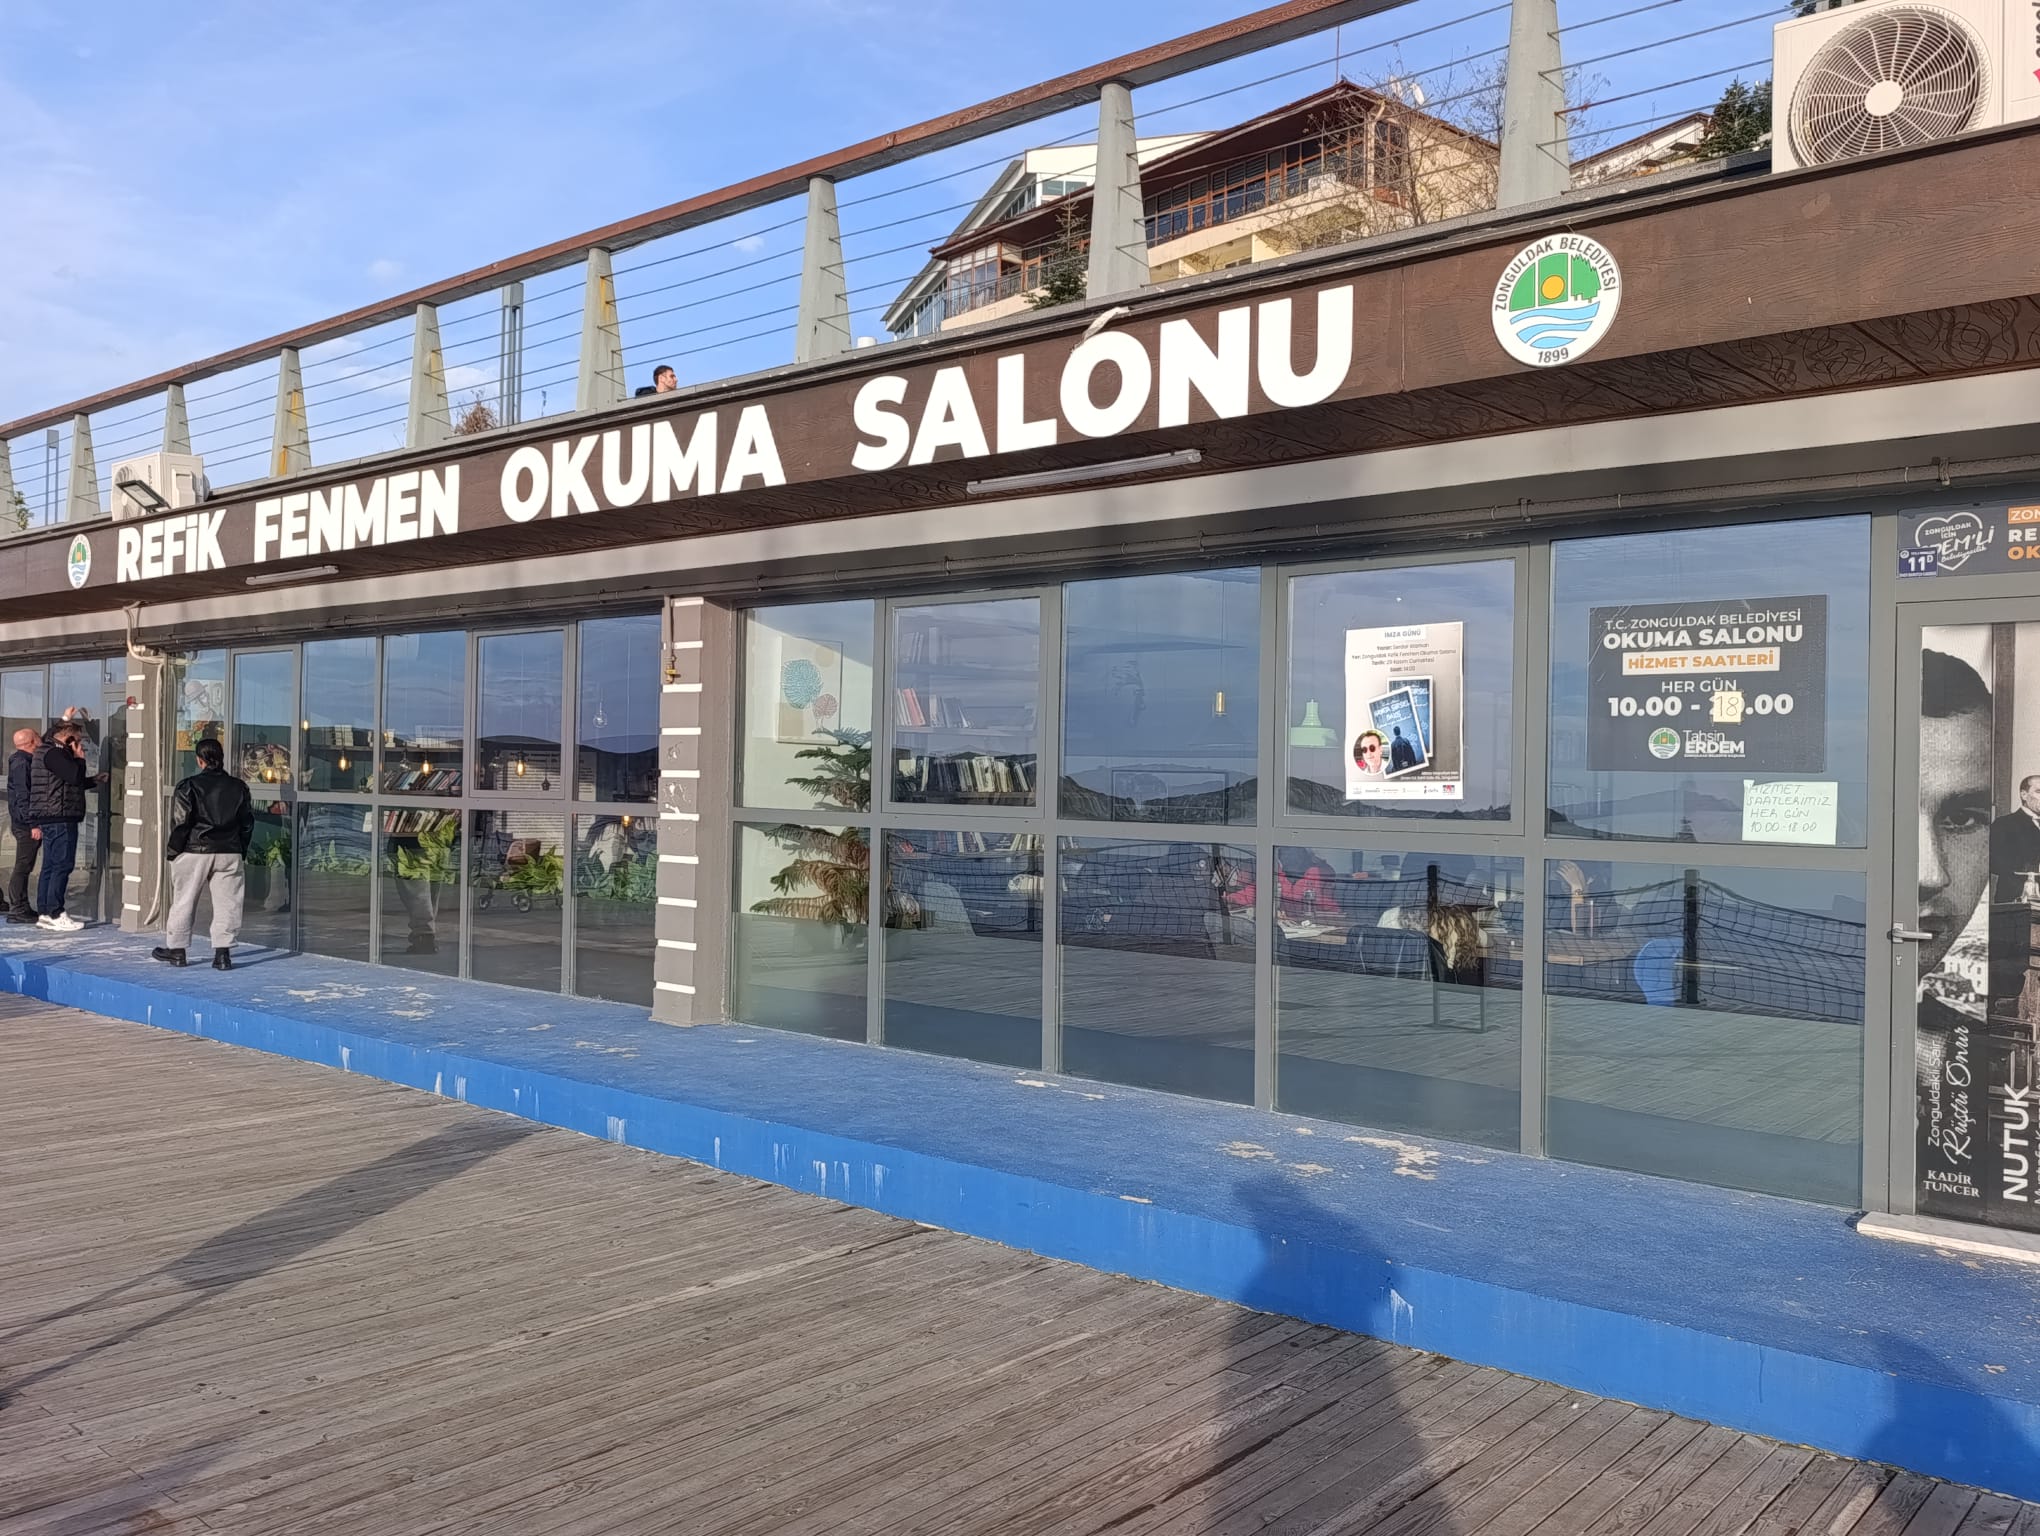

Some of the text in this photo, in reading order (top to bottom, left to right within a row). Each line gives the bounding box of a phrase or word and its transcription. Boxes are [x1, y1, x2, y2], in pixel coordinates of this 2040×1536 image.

[1494, 236, 1619, 312] ZONGULDAK BELEDİYESİ
[1537, 347, 1569, 364] 1899
[254, 464, 460, 563] FENMEN
[500, 404, 786, 523] OKUMA
[851, 285, 1354, 472] SALONU
[1925, 521, 1972, 537] ZONGULDAK
[2008, 528, 2038, 543] RE
[2007, 545, 2040, 560] OK
[1605, 608, 1802, 631] T.C. ZONGULDAK BELEDİYESİ
[1603, 624, 1804, 650] OKUMA SALONU
[1628, 650, 1774, 670] HİZMET SAATLERİ
[1661, 677, 1737, 693] HER GÜN
[1608, 695, 1683, 717] 10.00
[1682, 730, 1726, 742] Tahsin
[1685, 740, 1745, 754] ERDEM
[1750, 808, 1778, 818] HER
[1942, 1025, 1977, 1165] Rüştü Onur
[2003, 1082, 2030, 1202] NUTUK
[1927, 1169, 1973, 1185] KADİR
[1923, 1180, 1980, 1198] TUNCER
